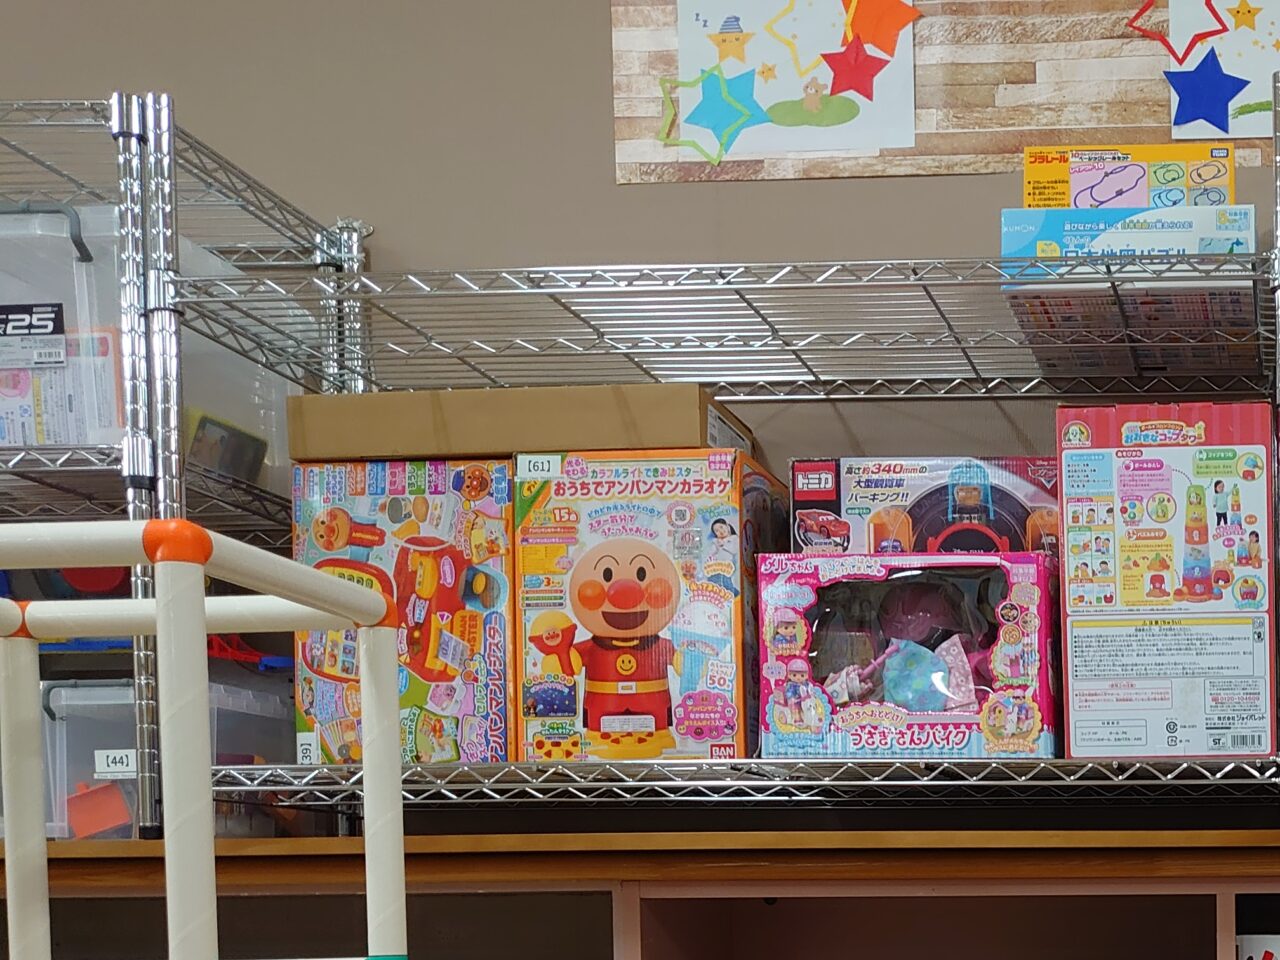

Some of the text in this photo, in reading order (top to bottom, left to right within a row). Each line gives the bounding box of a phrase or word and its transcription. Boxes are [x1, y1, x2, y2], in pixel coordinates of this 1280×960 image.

[1029, 155, 1068, 164] プラレール
[528, 461, 551, 473] 【61】
[845, 463, 927, 475] 高さ約340mmの
[797, 473, 834, 490] トミカ
[853, 478, 905, 489] 大型観覧車
[554, 479, 730, 497] おうちでアンパンマンカラオケ
[848, 492, 909, 503] パーキング!!
[763, 558, 814, 574] メルちゃん
[851, 728, 971, 749] うさぎさんバイク
[106, 755, 129, 768] 【44】
